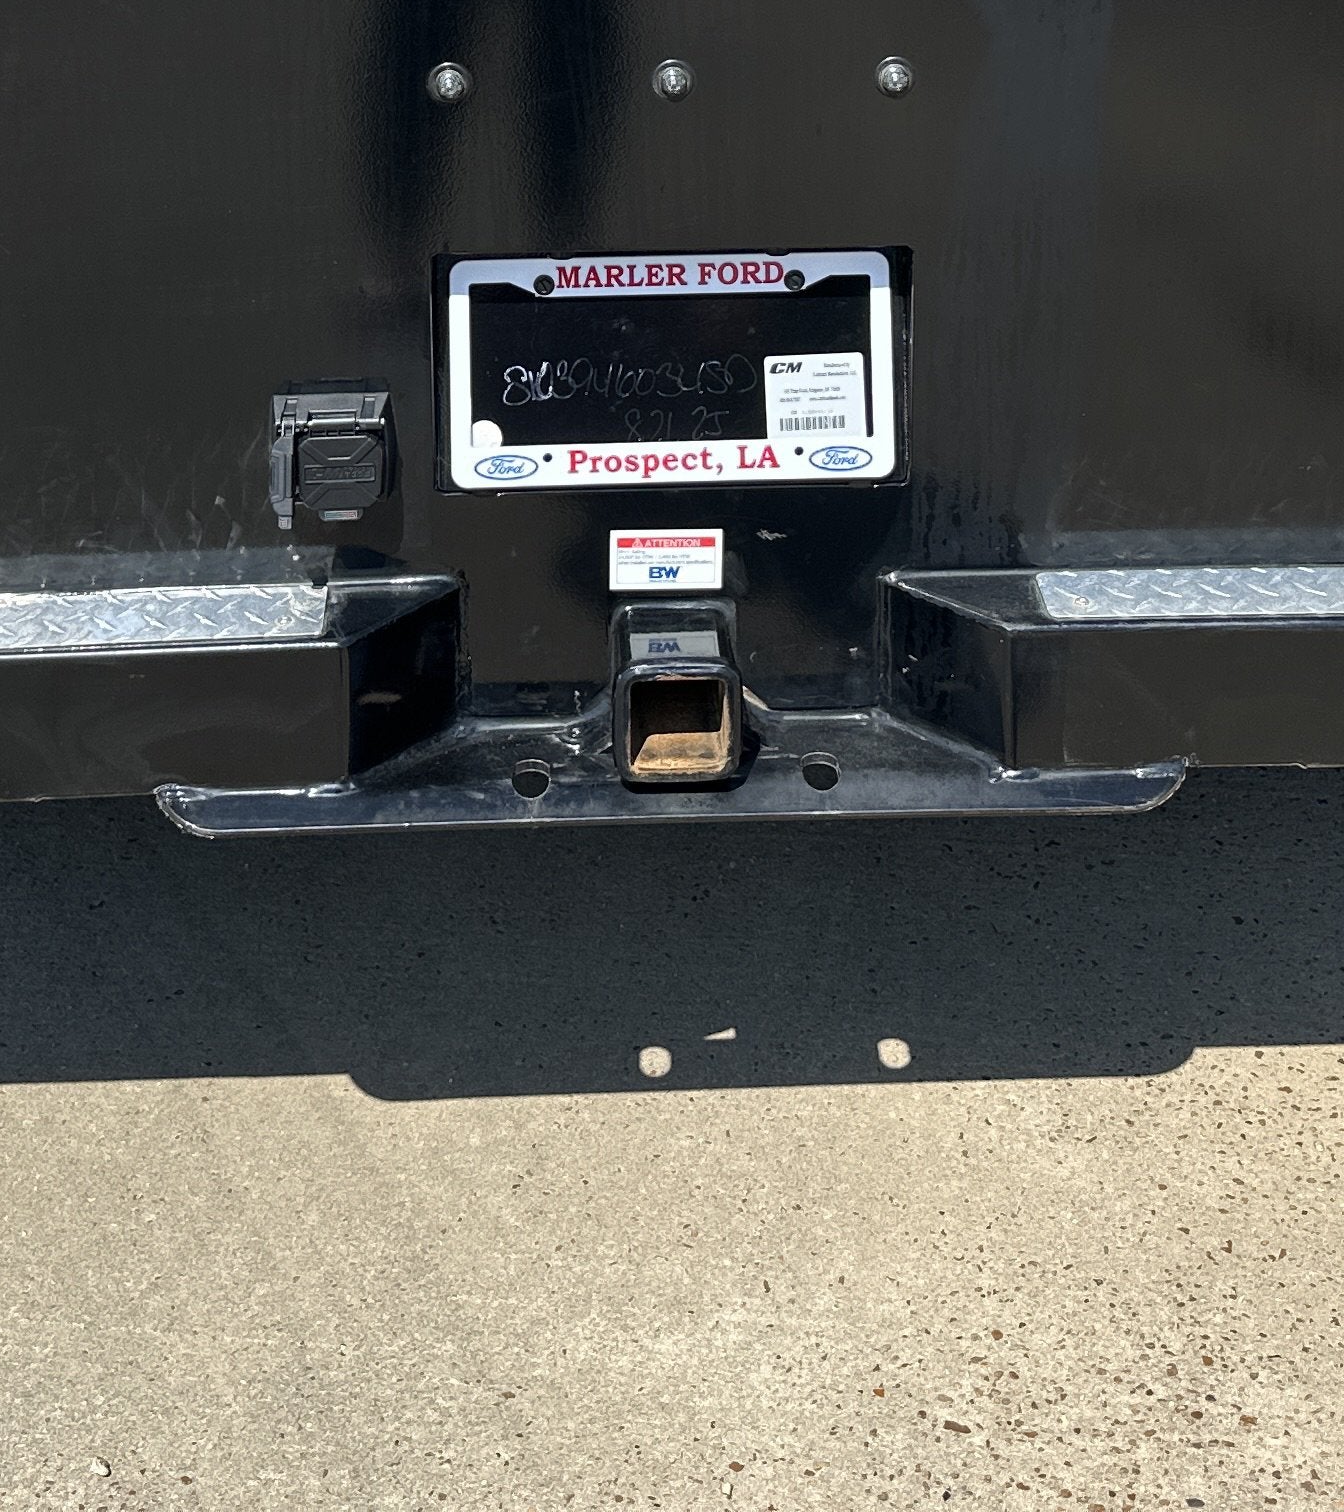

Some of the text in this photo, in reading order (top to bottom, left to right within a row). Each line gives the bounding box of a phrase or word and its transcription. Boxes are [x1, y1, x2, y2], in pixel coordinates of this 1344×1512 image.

[556, 260, 784, 288] MARLER FORD
[769, 361, 803, 375] CM
[486, 457, 526, 476] Ford
[568, 444, 781, 478] Prospect, LA
[821, 449, 860, 468] Ford
[644, 538, 702, 548] ATTENTION
